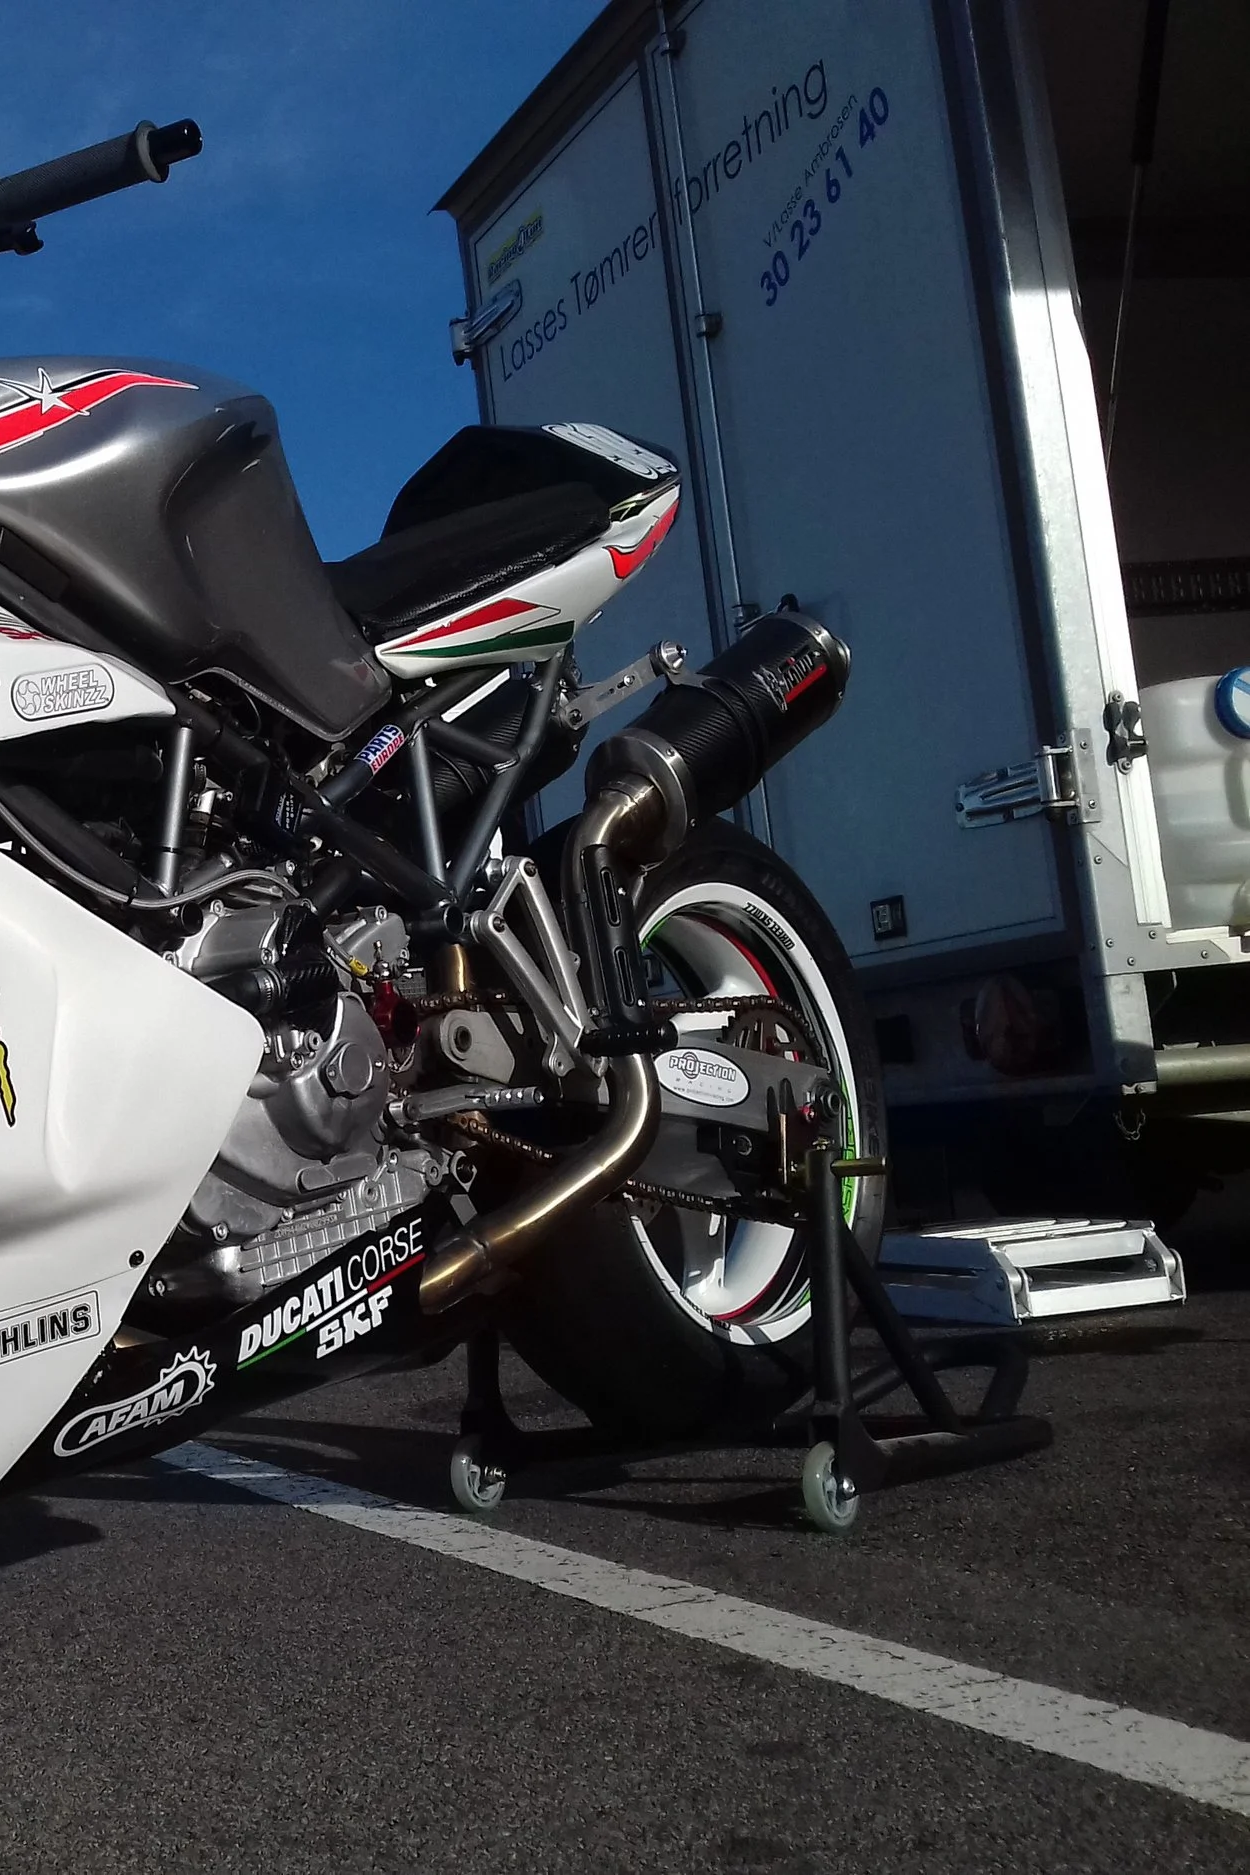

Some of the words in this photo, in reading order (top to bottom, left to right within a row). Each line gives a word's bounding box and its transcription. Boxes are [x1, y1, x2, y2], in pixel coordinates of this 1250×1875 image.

[760, 250, 790, 307] 30
[790, 198, 822, 261] 23
[825, 145, 853, 204] 61
[858, 86, 889, 149] 40
[500, 298, 567, 382] Lasses
[40, 669, 99, 696] WHEEL
[42, 685, 107, 714] SKINZZ
[355, 725, 401, 764] PARTS
[370, 733, 405, 772] EUROPE
[669, 1053, 737, 1082] PROJECTION
[237, 1265, 345, 1363] DUCATI
[347, 1217, 424, 1291] CORSE
[315, 1284, 393, 1360] SKF
[80, 1380, 187, 1444] AFAM
